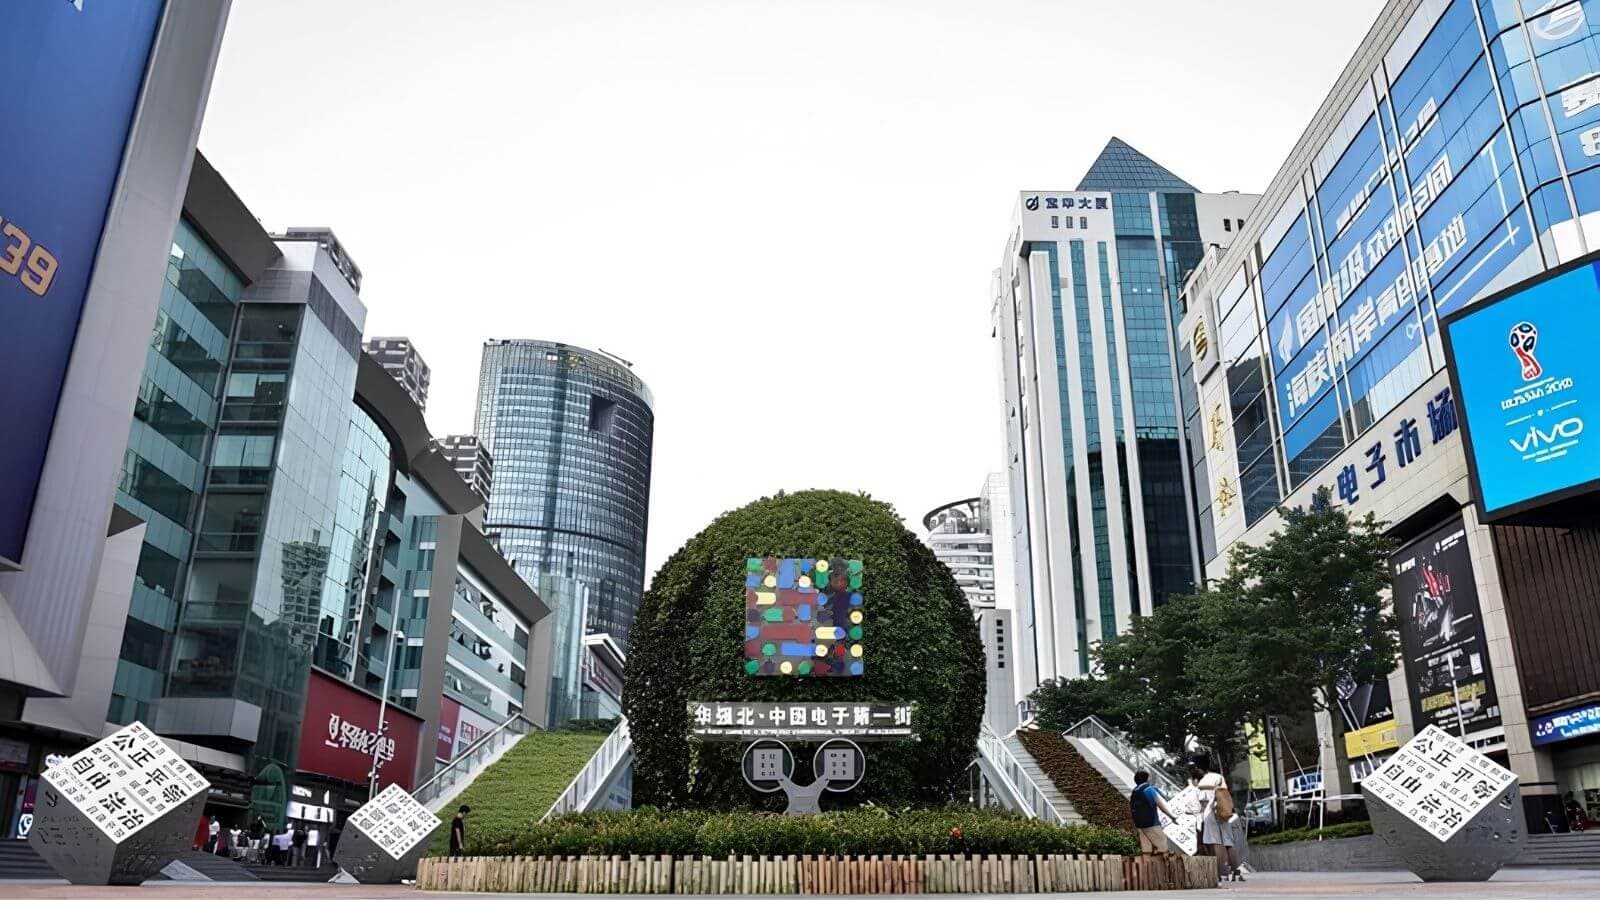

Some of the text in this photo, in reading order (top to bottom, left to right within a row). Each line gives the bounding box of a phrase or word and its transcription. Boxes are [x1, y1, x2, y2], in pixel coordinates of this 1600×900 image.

[0, 216, 58, 296] 39
[1293, 387, 1459, 518] 电子市场
